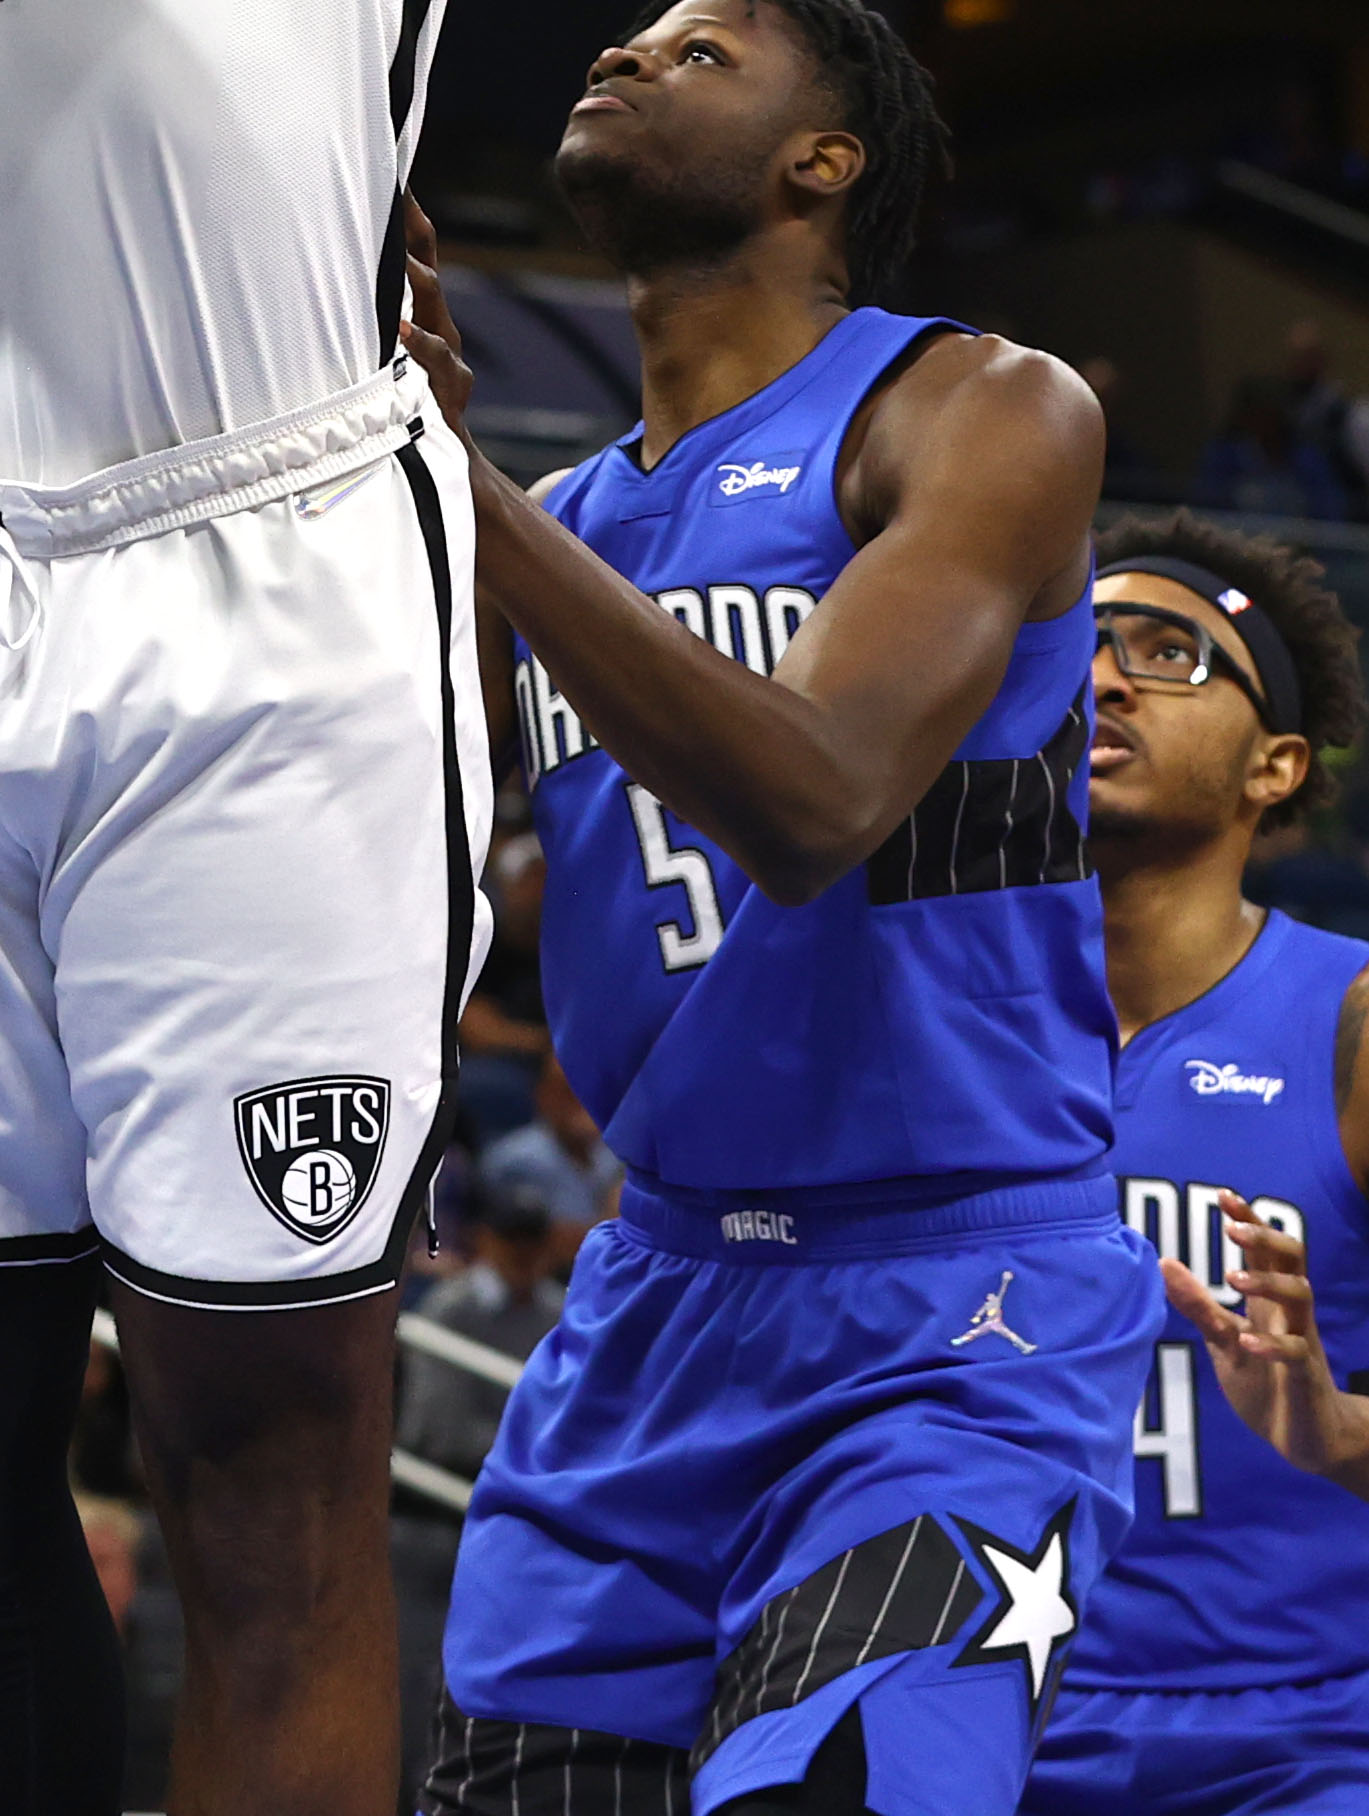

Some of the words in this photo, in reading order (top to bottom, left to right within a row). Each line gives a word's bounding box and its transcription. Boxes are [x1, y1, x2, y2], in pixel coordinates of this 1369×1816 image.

[717, 462, 800, 496] Disney
[627, 783, 728, 974] 5
[1184, 1060, 1286, 1104] Disney
[251, 1088, 380, 1160] NETS
[310, 1161, 333, 1217] B
[721, 1210, 797, 1245] MAGIC
